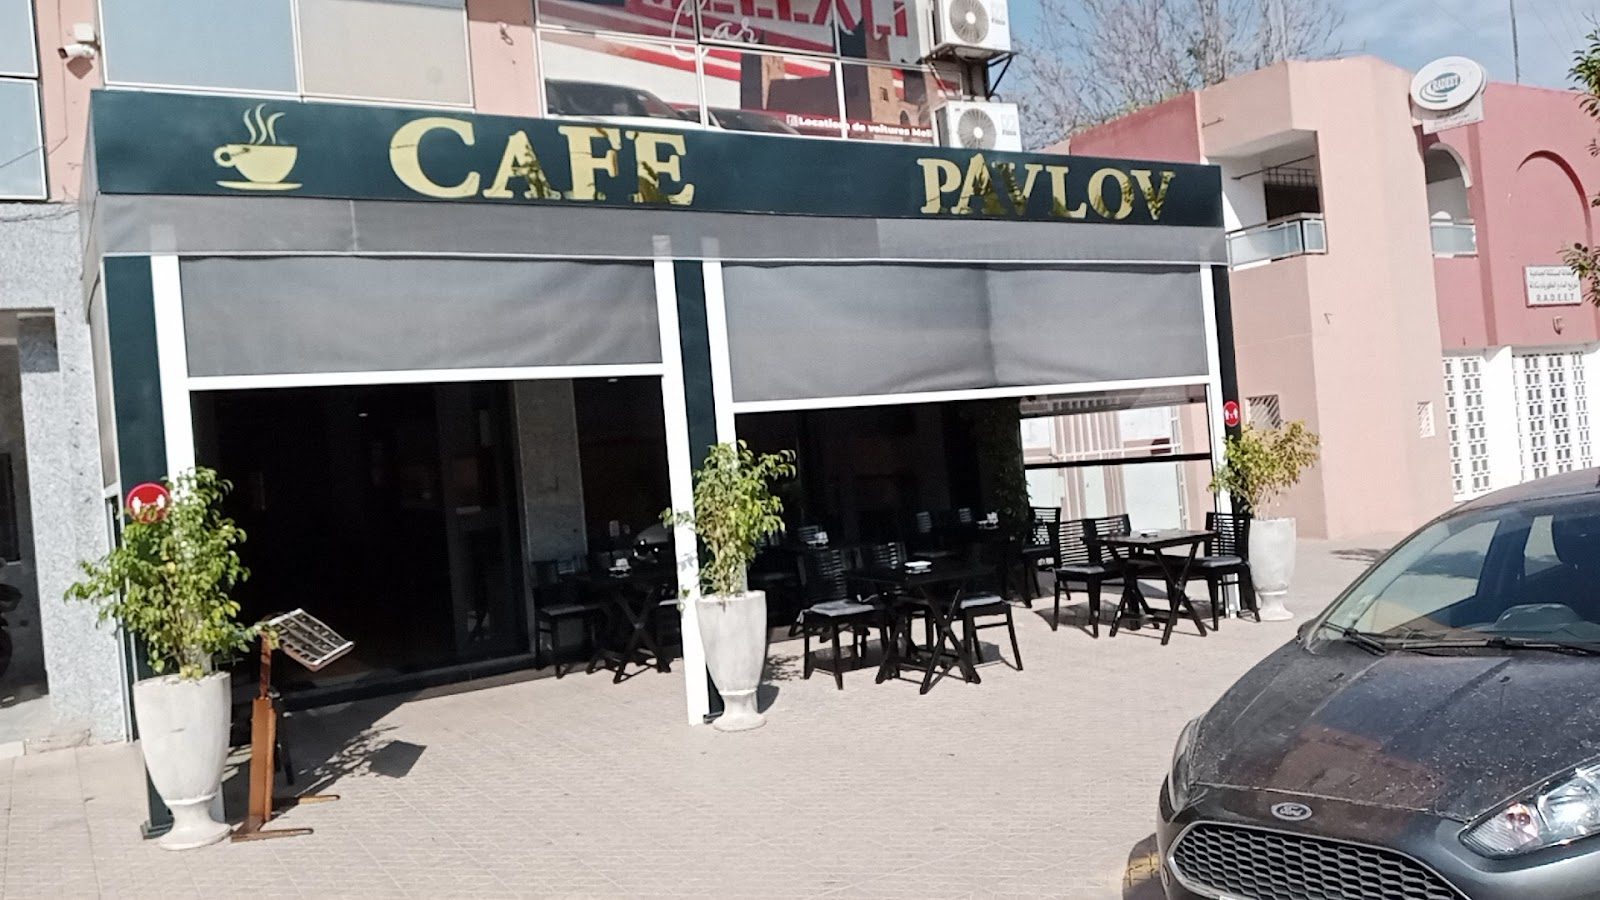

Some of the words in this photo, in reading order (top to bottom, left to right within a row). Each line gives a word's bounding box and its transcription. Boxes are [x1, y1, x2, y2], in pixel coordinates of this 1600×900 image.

[852, 122, 866, 132] de
[868, 124, 910, 136] voitures
[389, 117, 695, 206] CAFE
[916, 152, 1177, 221] PAVLOV
